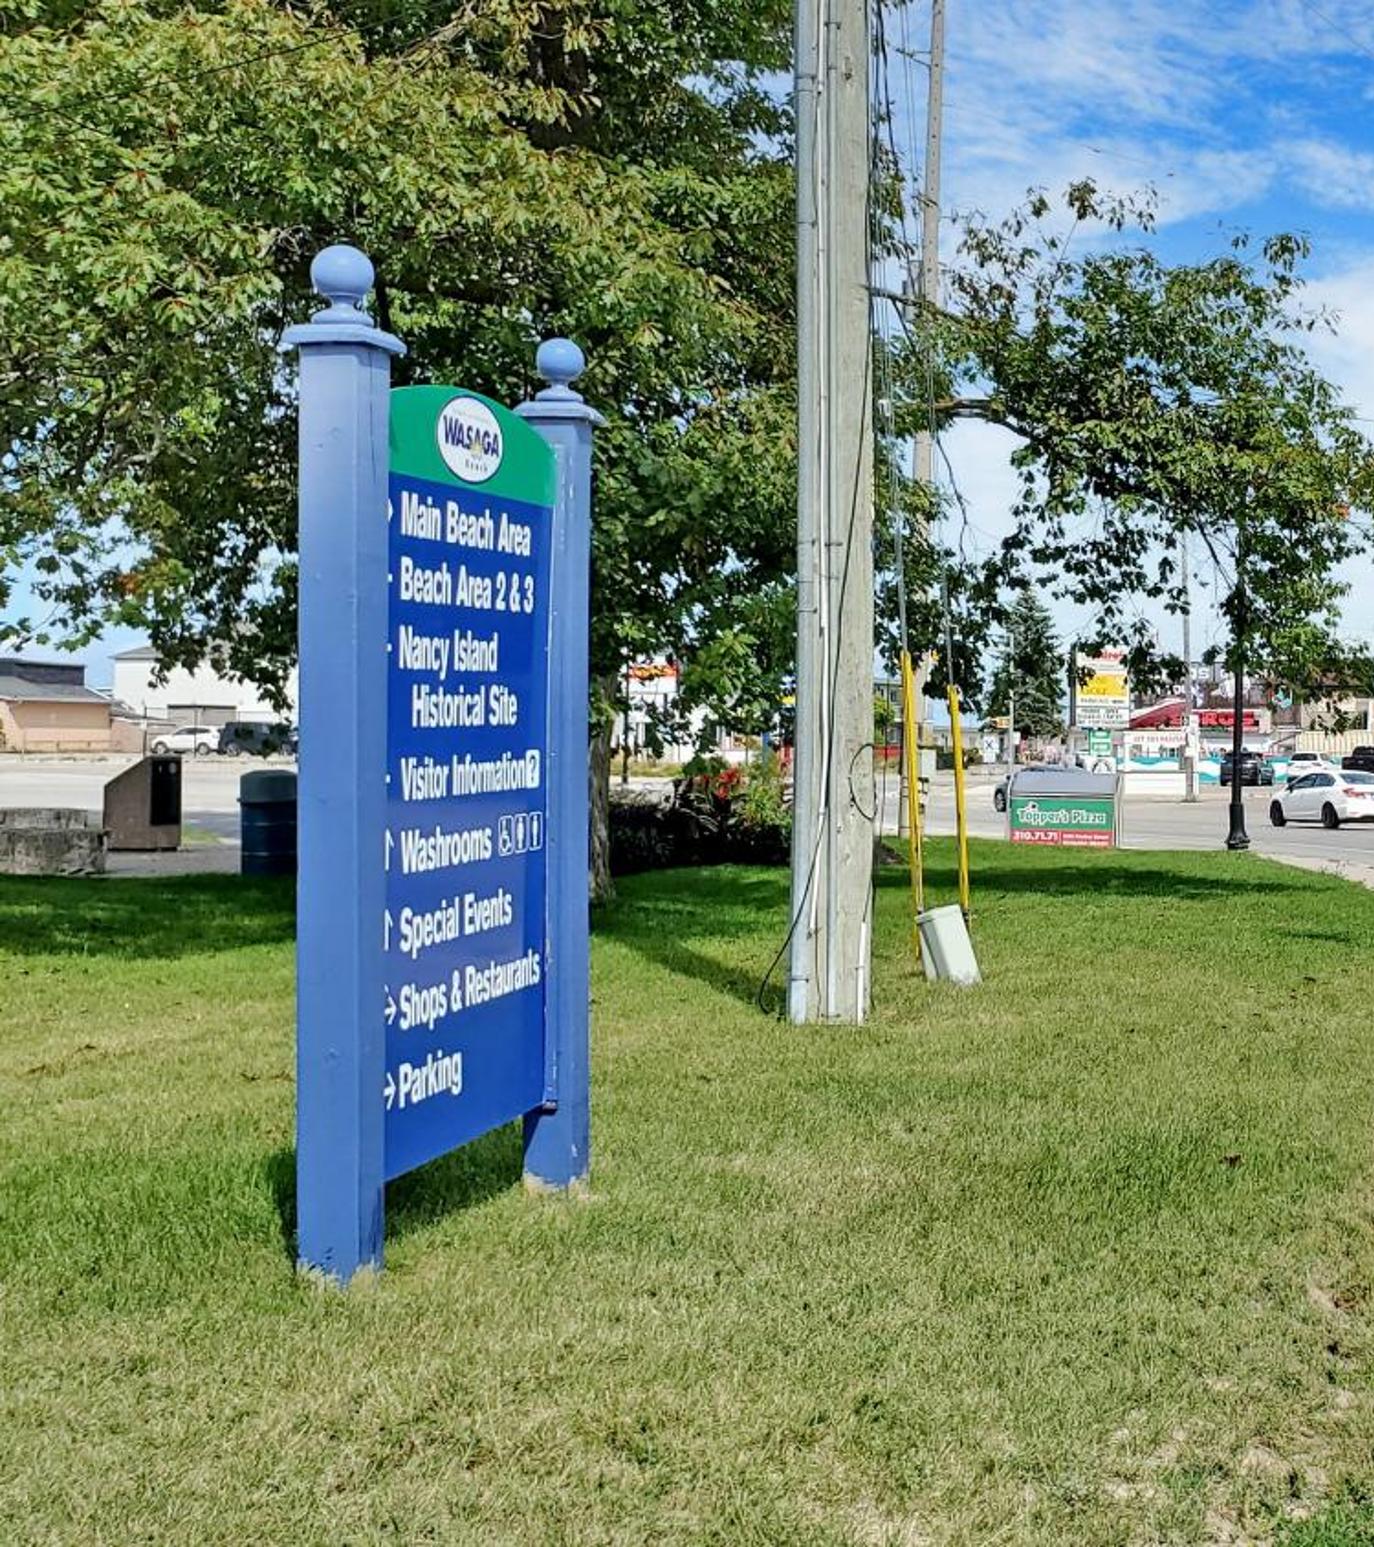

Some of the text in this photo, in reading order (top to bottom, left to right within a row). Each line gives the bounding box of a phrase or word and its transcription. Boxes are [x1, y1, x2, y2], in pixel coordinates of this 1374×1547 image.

[443, 415, 499, 457] WASAGA
[401, 491, 531, 556] Main Beach Area
[400, 557, 534, 614] Beach Area 2 & 3
[400, 626, 498, 680] Nancy Island
[412, 685, 518, 728] Historical Site
[400, 757, 449, 801] Visitor
[452, 748, 526, 796] Information
[1017, 806, 1106, 825] Topper's Pizza
[401, 826, 491, 874] Washrooms
[399, 889, 511, 959] Special Events
[399, 949, 540, 1031] Shops & Restaurants
[398, 1052, 462, 1108] Parking
